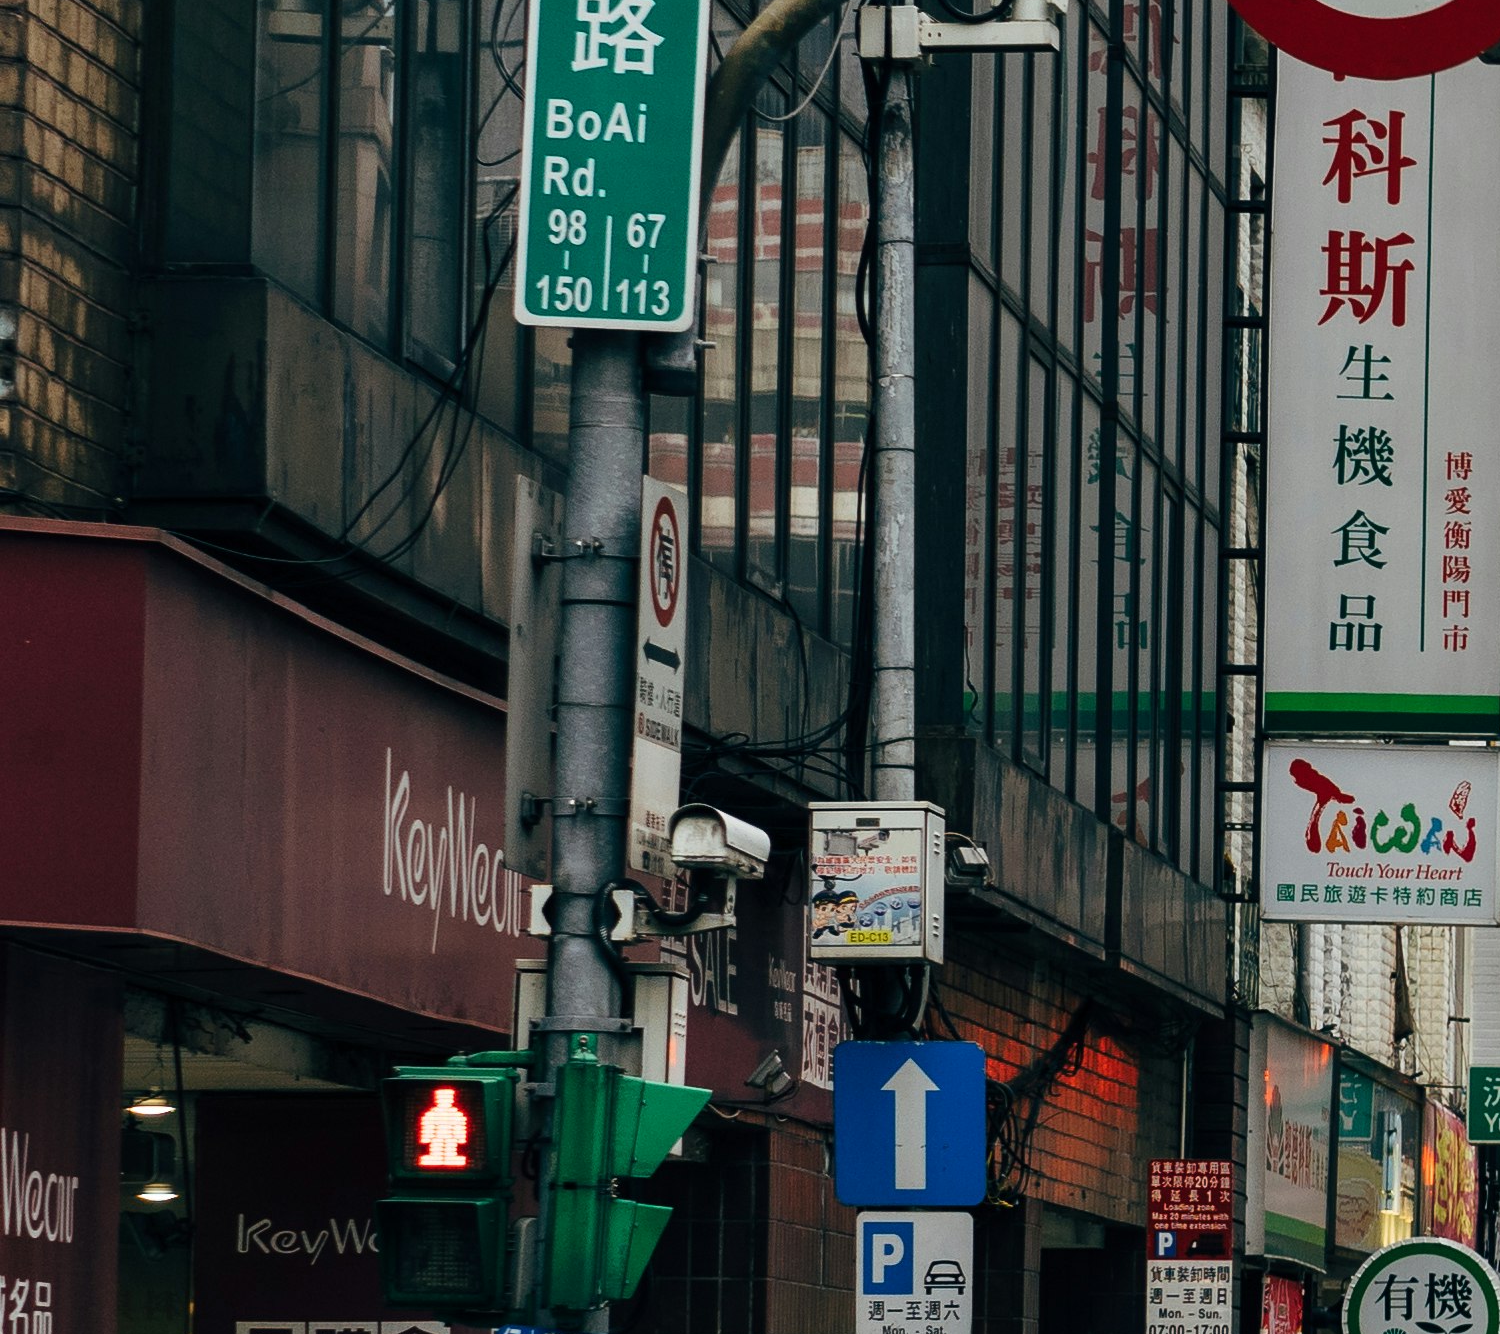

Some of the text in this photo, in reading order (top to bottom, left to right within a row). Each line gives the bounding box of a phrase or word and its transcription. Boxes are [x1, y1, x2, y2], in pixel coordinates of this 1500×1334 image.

[546, 98, 648, 144] BoAi
[543, 156, 606, 198] Rd.
[1318, 69, 1418, 328] 科斯
[547, 211, 666, 248] 98 67
[536, 276, 670, 317] 150 113
[1329, 345, 1396, 654] 生機食品
[1443, 451, 1474, 654] 博愛衡陽門市
[1327, 862, 1463, 881] Touch Your Heart
[1276, 883, 1483, 907] 國民旅遊卡特約商店
[850, 932, 889, 943] ED-C13
[691, 930, 738, 1016] SALE
[1164, 1204, 1194, 1213] Loading
[1151, 1266, 1231, 1283] 貨車裝卸時間
[869, 1301, 960, 1320] 週一至週六
[1149, 1288, 1227, 1305] 週一至週日
[1158, 1308, 1222, 1319] Mon. Sun.
[1374, 1272, 1473, 1322] 有機
